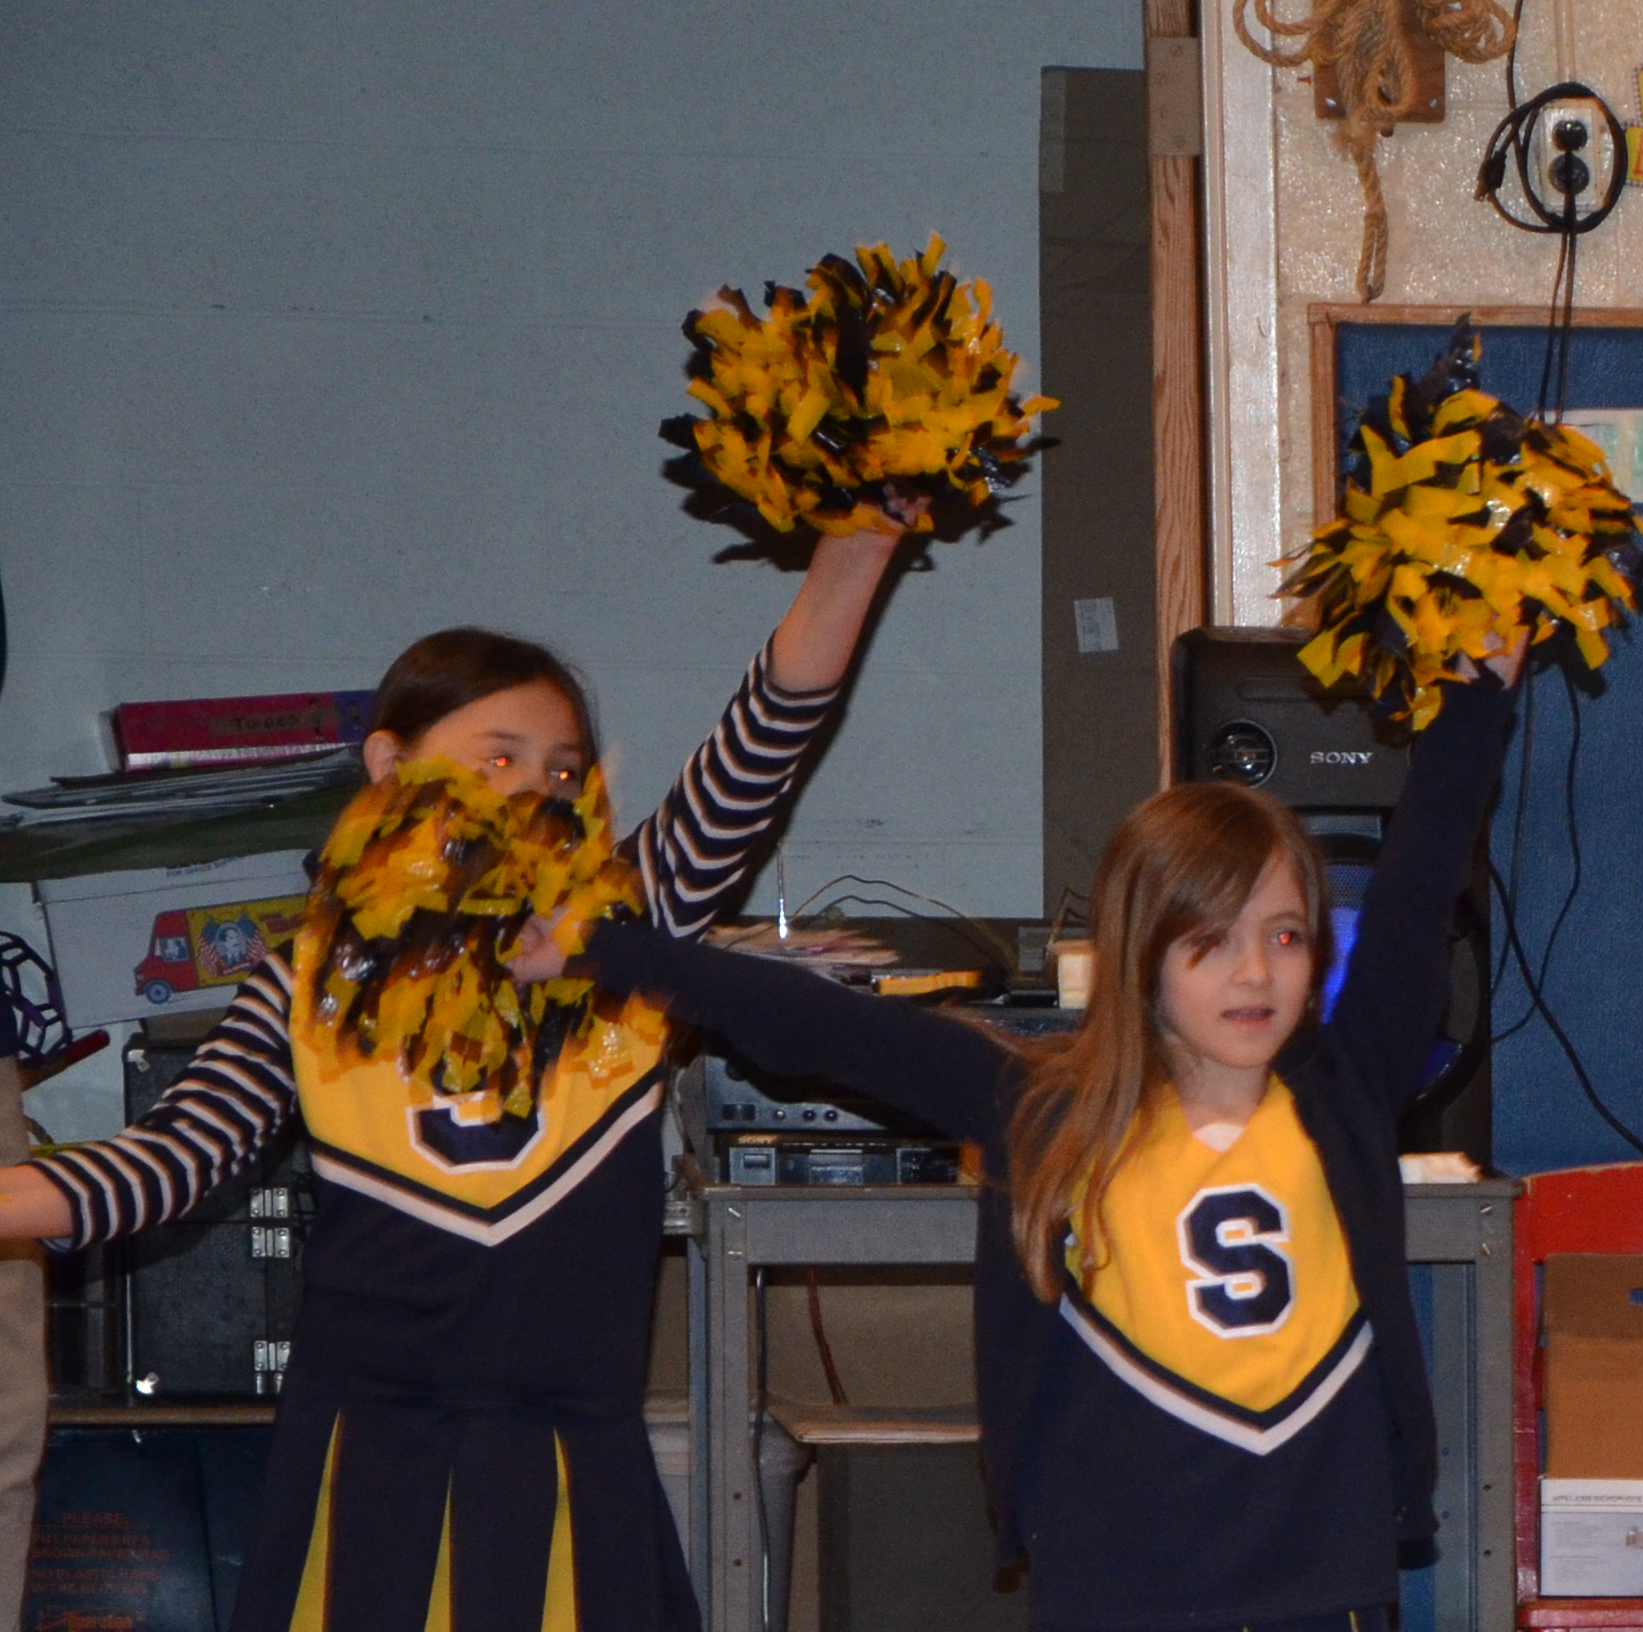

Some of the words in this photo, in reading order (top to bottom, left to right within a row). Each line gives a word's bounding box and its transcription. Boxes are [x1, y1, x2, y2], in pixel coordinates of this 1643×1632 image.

[1310, 752, 1373, 764] SONY
[738, 1134, 778, 1145] SONY
[1176, 1182, 1294, 1340] S
